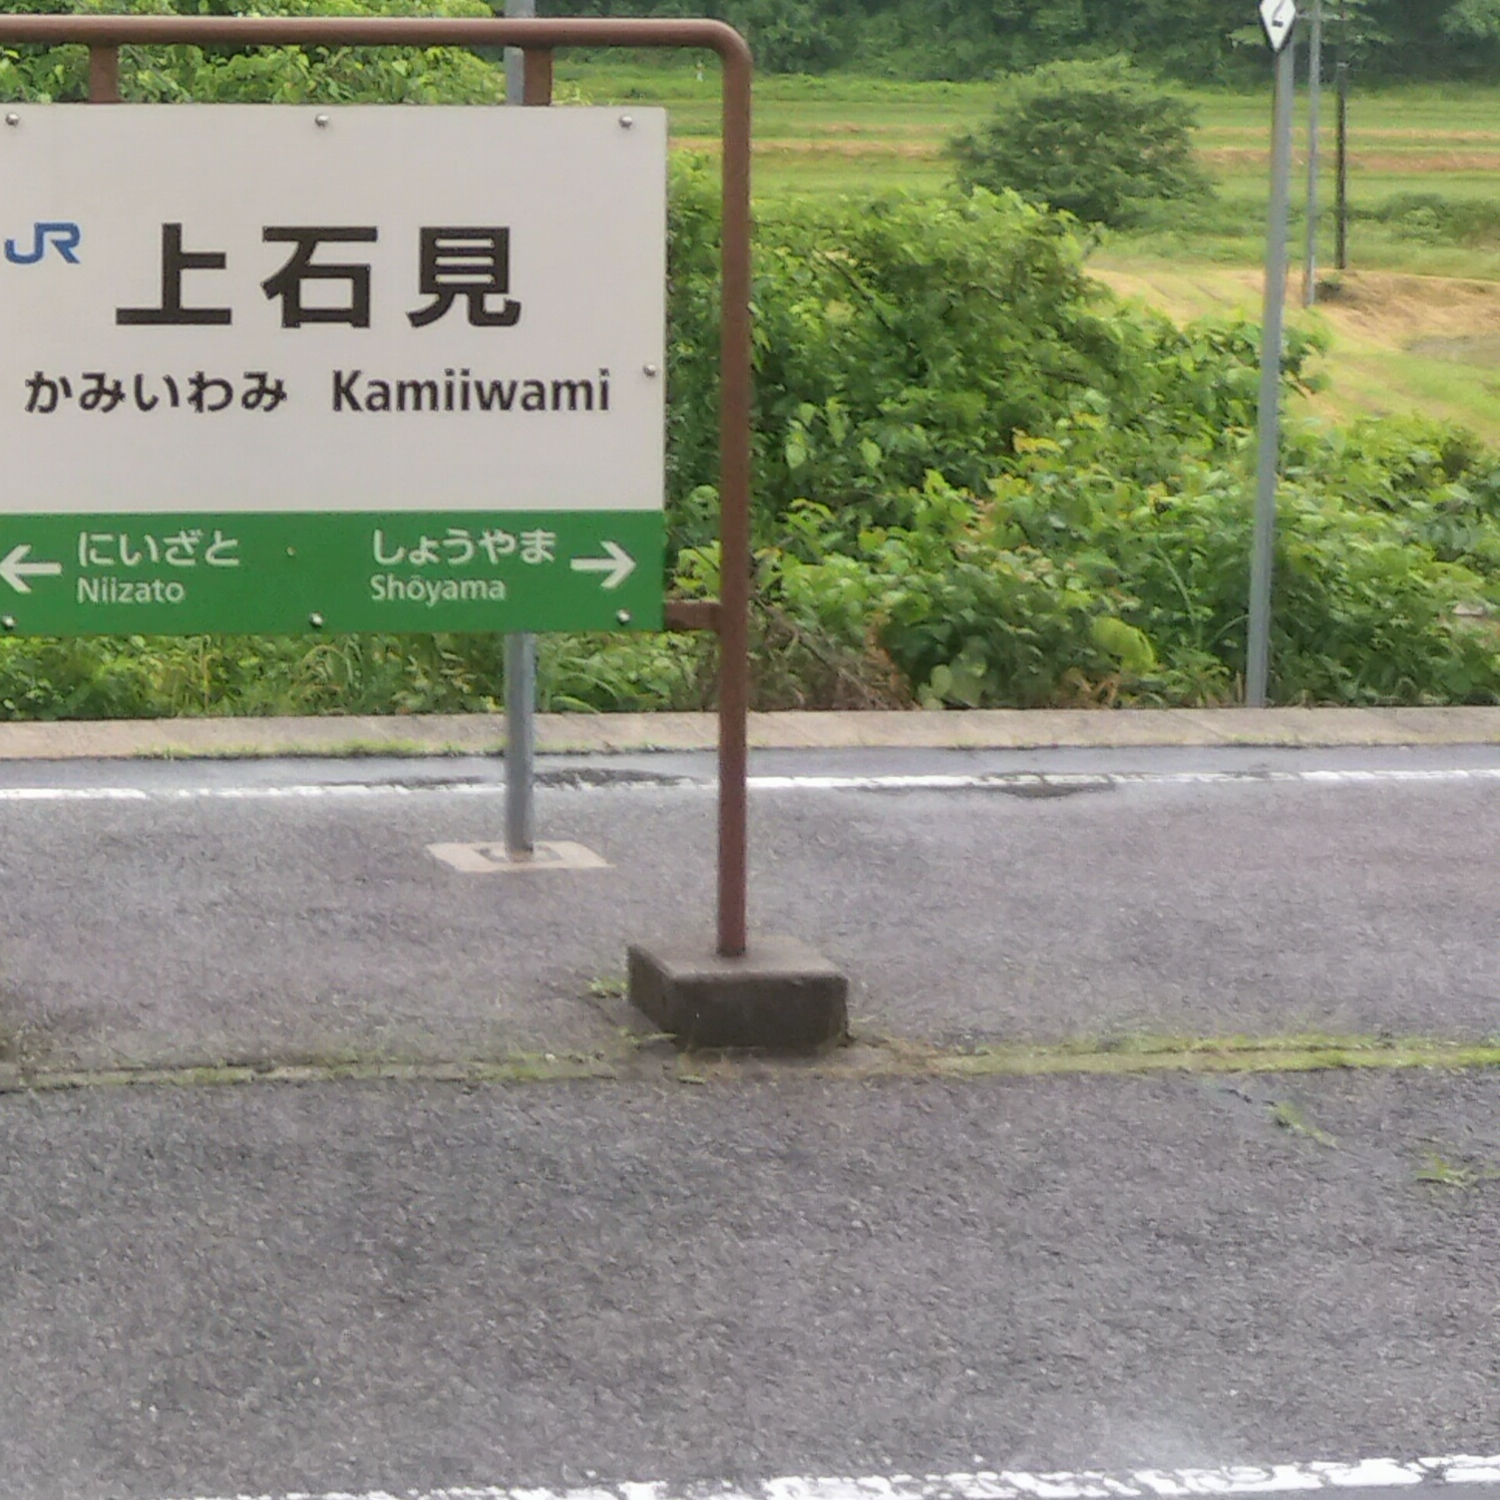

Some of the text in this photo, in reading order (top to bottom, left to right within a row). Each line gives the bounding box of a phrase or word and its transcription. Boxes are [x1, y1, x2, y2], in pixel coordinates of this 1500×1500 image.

[4, 221, 81, 264] JR
[115, 222, 522, 329] 上石見
[24, 369, 611, 414] かみいわみ Kamiiwami
[78, 529, 240, 567] にいざと
[373, 528, 557, 566] しょうやま
[77, 576, 186, 603] Niizato
[370, 572, 507, 607] Shōyama
